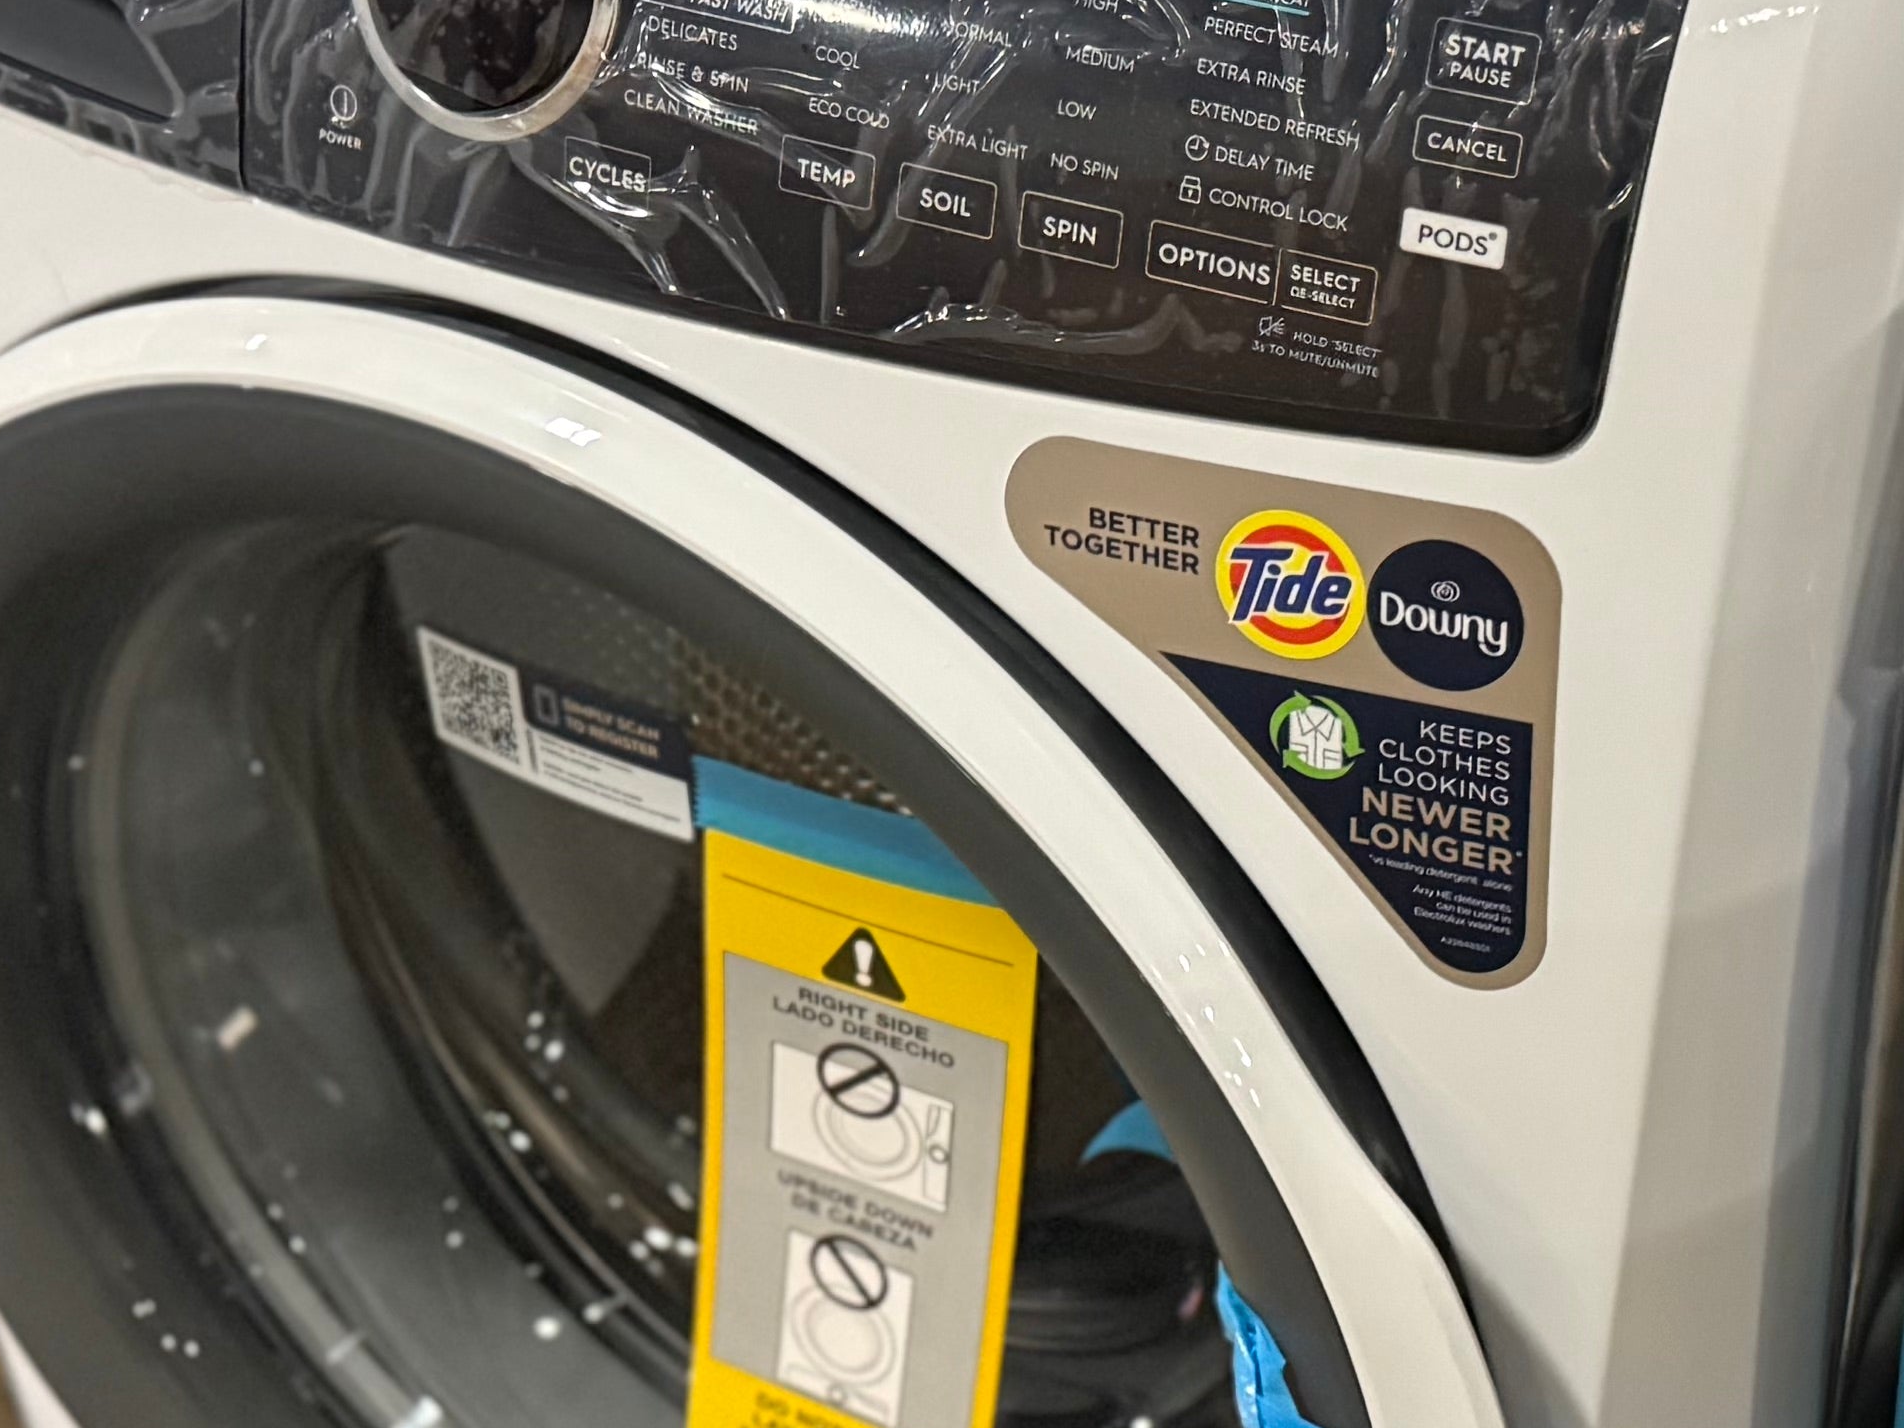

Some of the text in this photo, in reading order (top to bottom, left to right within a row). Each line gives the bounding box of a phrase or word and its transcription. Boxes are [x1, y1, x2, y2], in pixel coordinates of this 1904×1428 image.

[647, 15, 738, 51] DELICATES
[1204, 15, 1340, 57] PERFECT STEAM
[1445, 33, 1526, 69] START
[815, 46, 860, 69] COOL
[1065, 45, 1136, 73] MEDIUM
[1448, 60, 1513, 89] PAUSE
[1197, 57, 1306, 96] EXTRA RINSE
[624, 88, 680, 116] CLEAN
[809, 97, 842, 118] ECO
[1057, 99, 1097, 121] LOW
[319, 128, 361, 150] POWER
[927, 123, 1028, 160] EXTRA LIGHT
[1190, 98, 1361, 151] EXTENDED REFRESH
[1214, 145, 1315, 182] DELAY TIME
[1427, 131, 1508, 164] CANCEL
[568, 155, 647, 193] CYCLES
[796, 156, 856, 188] TEMP
[1050, 152, 1119, 181] NO SPIN
[919, 187, 972, 217] SOIL
[1208, 186, 1349, 233] CONTROL LOCK
[1042, 214, 1097, 246] SPIN
[1158, 242, 1271, 288] OPTIONS
[1290, 264, 1361, 293] SELECT
[1293, 331, 1329, 349] HOLD
[1269, 343, 1286, 357] TO
[1288, 348, 1380, 379] MUTE/UNMUTE
[1089, 506, 1200, 550] BETTER
[1043, 523, 1200, 575] TOGETHER
[1228, 544, 1353, 623] Tide
[1379, 591, 1508, 657] Downy
[1419, 719, 1512, 756] KEEPS
[1379, 737, 1511, 781] CLOTHES
[1378, 762, 1510, 807] LOOKING
[1362, 786, 1512, 843] NEWER
[1385, 857, 1425, 876] leading
[1425, 867, 1478, 886] detergent
[1412, 884, 1435, 899] Any
[1453, 892, 1512, 914] detergents
[1414, 905, 1466, 927] Electrolux
[1435, 900, 1456, 914] can
[1456, 904, 1472, 917] be
[1472, 908, 1500, 923] used
[798, 985, 931, 1043] RIGHT SIDE
[772, 996, 956, 1070] LADO DERECHO
[777, 1169, 935, 1239] UPSIDE DOWN
[790, 1192, 918, 1253] DE CABEZA
[756, 1392, 790, 1417] DO
